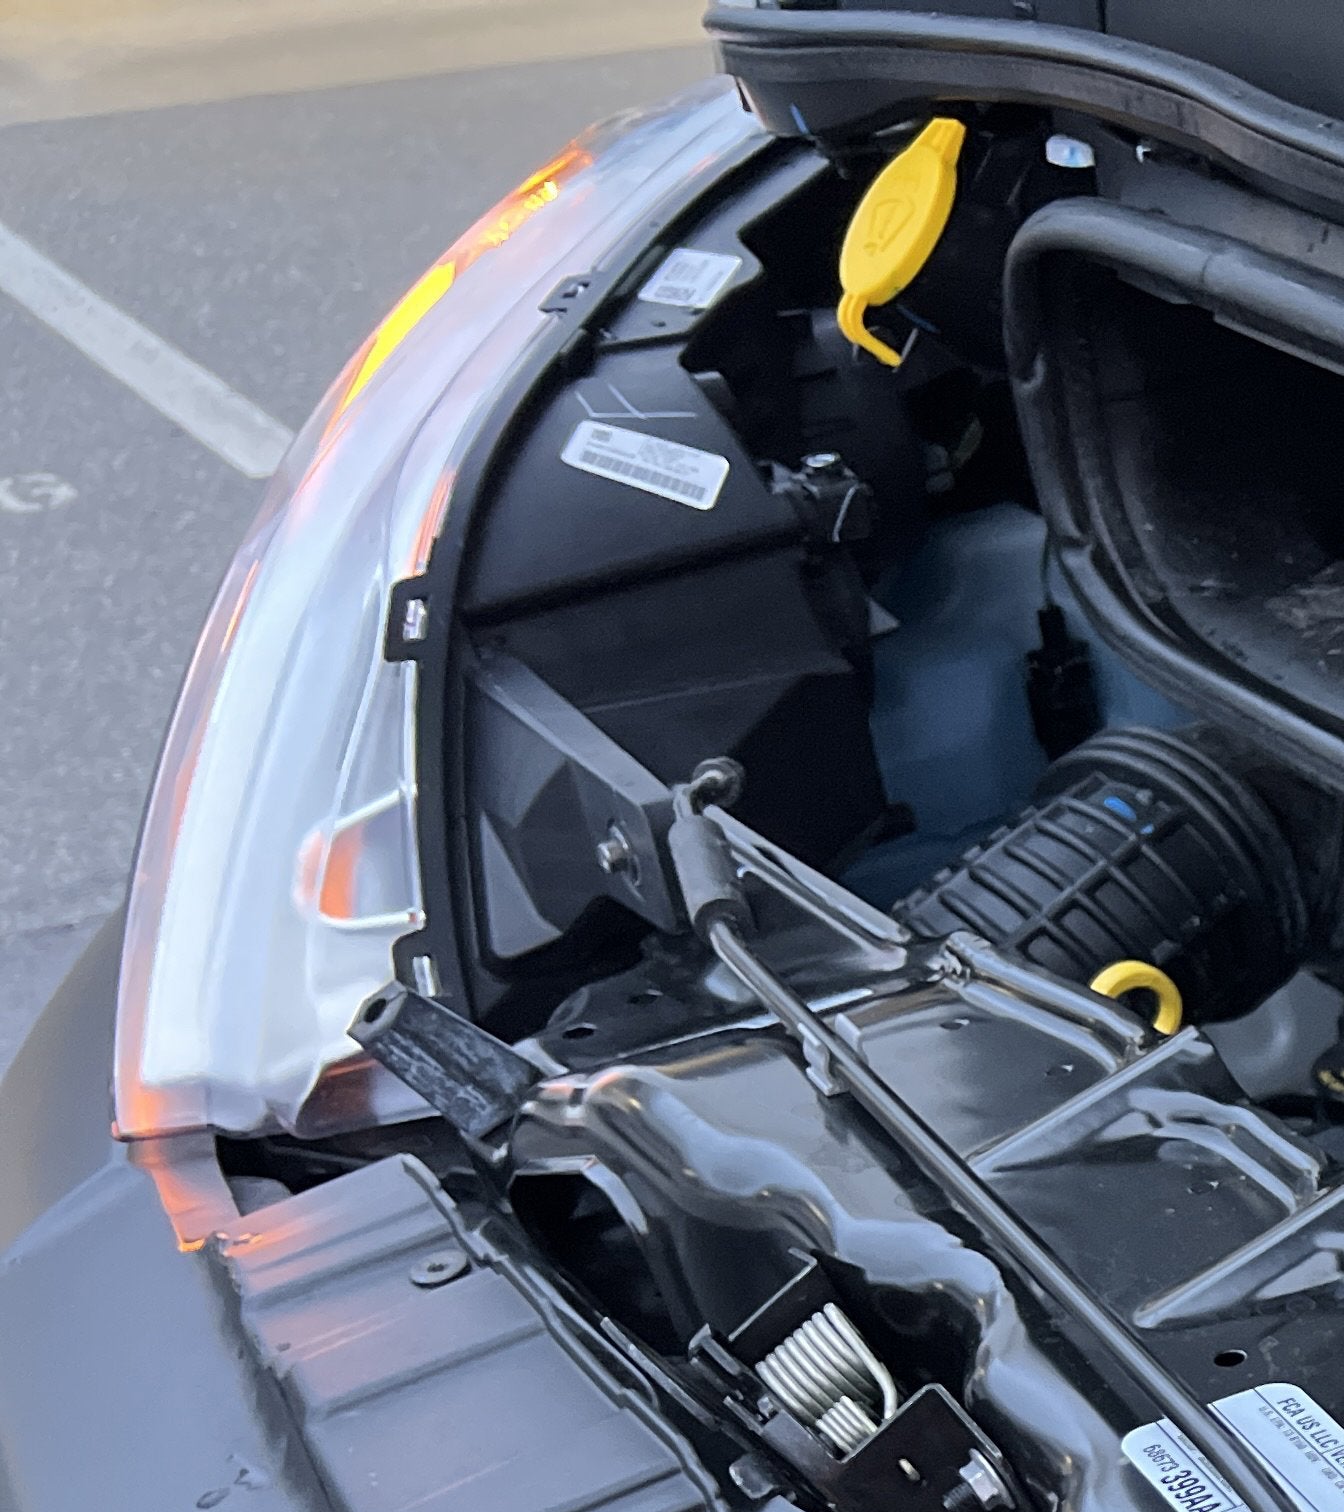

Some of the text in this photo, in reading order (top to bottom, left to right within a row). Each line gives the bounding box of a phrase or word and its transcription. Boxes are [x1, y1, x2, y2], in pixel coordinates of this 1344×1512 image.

[1276, 1395, 1339, 1450] FCA US LLC
